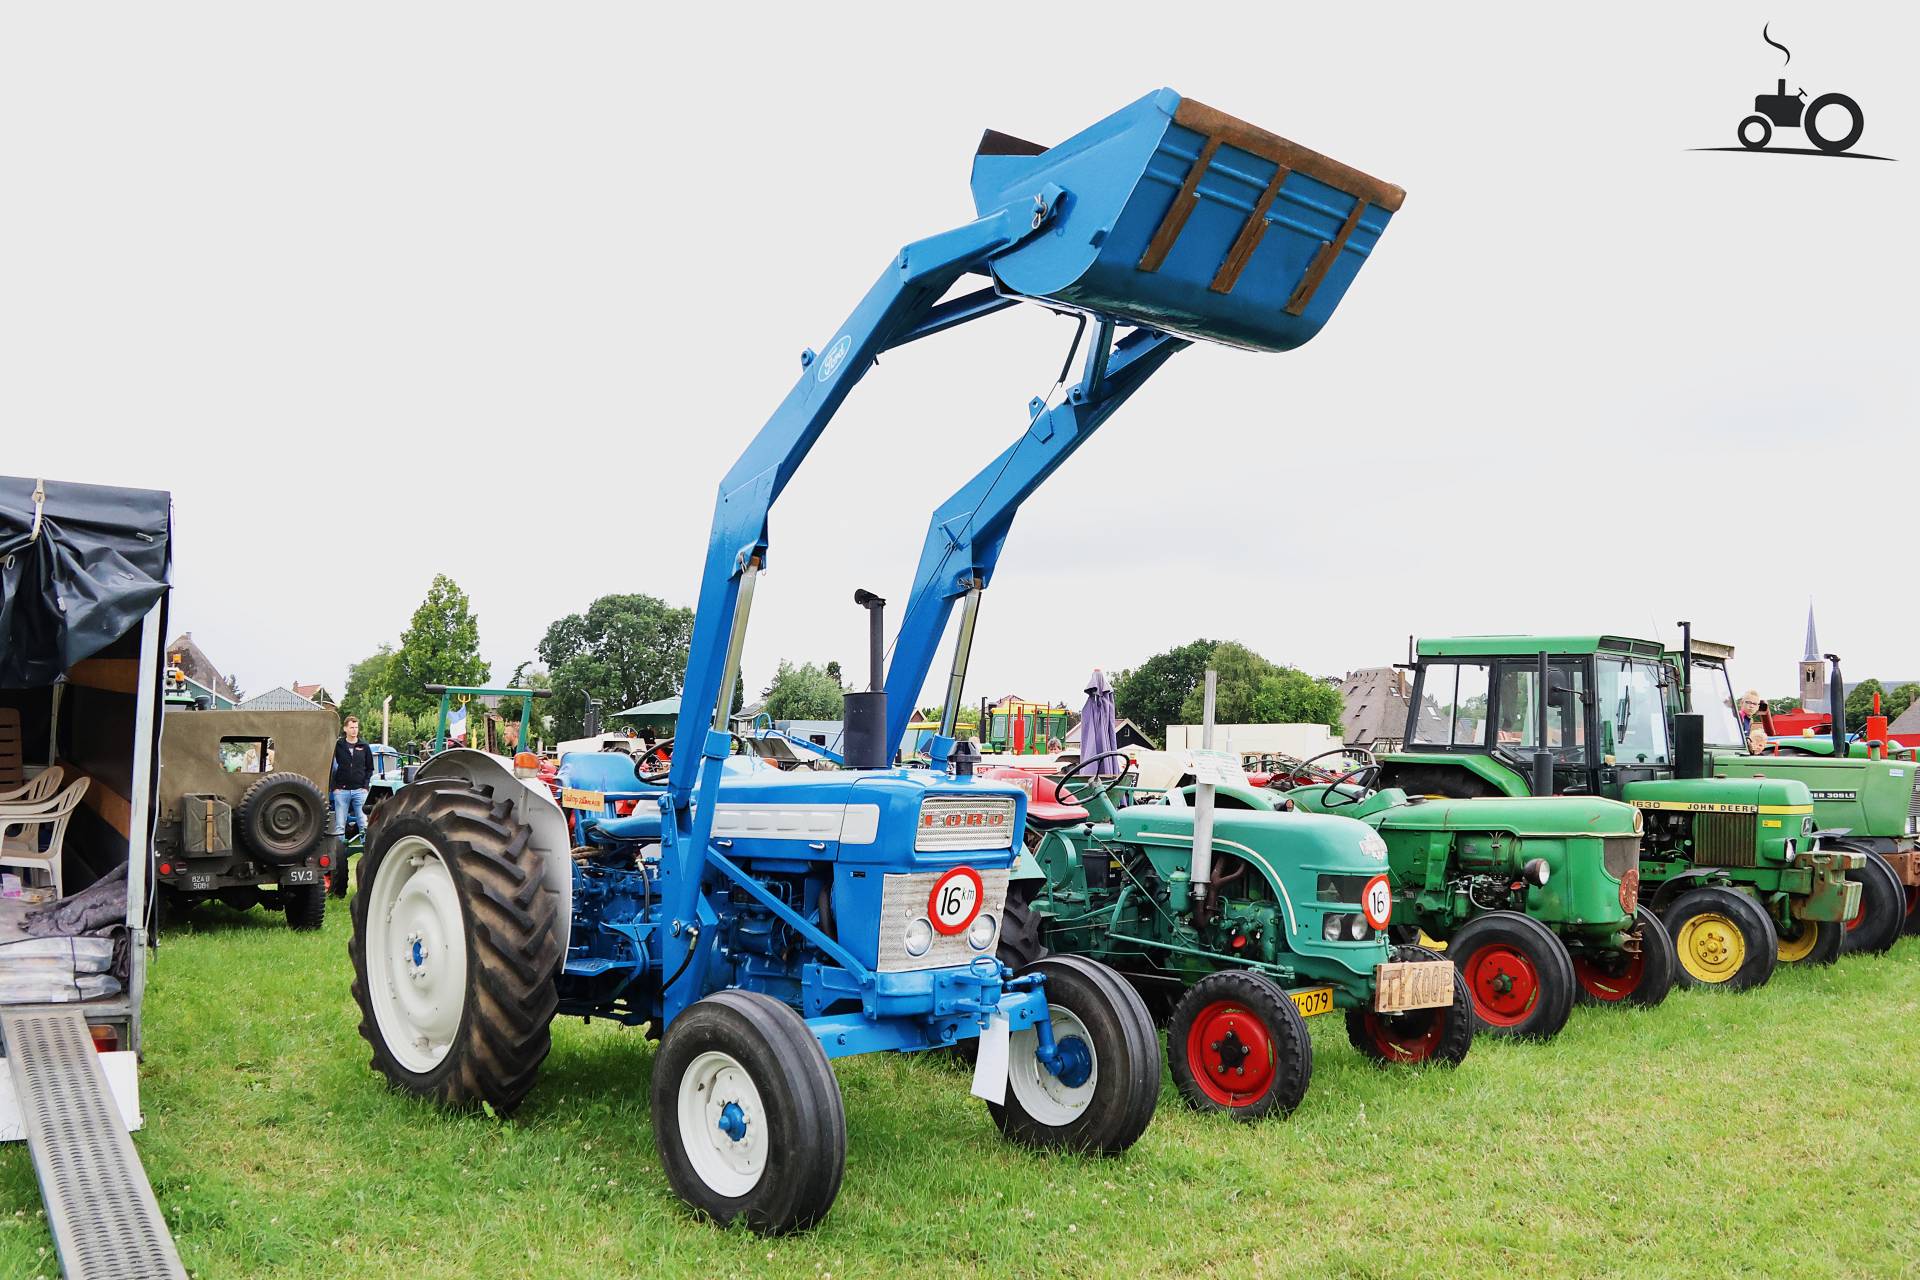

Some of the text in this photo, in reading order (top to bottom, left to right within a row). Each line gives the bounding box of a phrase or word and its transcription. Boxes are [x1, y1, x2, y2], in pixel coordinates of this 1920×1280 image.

[1687, 803, 1757, 813] JOHN DEERE
[940, 886, 961, 916] 16
[1372, 891, 1385, 915] 16
[1411, 966, 1452, 1005] KOOP
